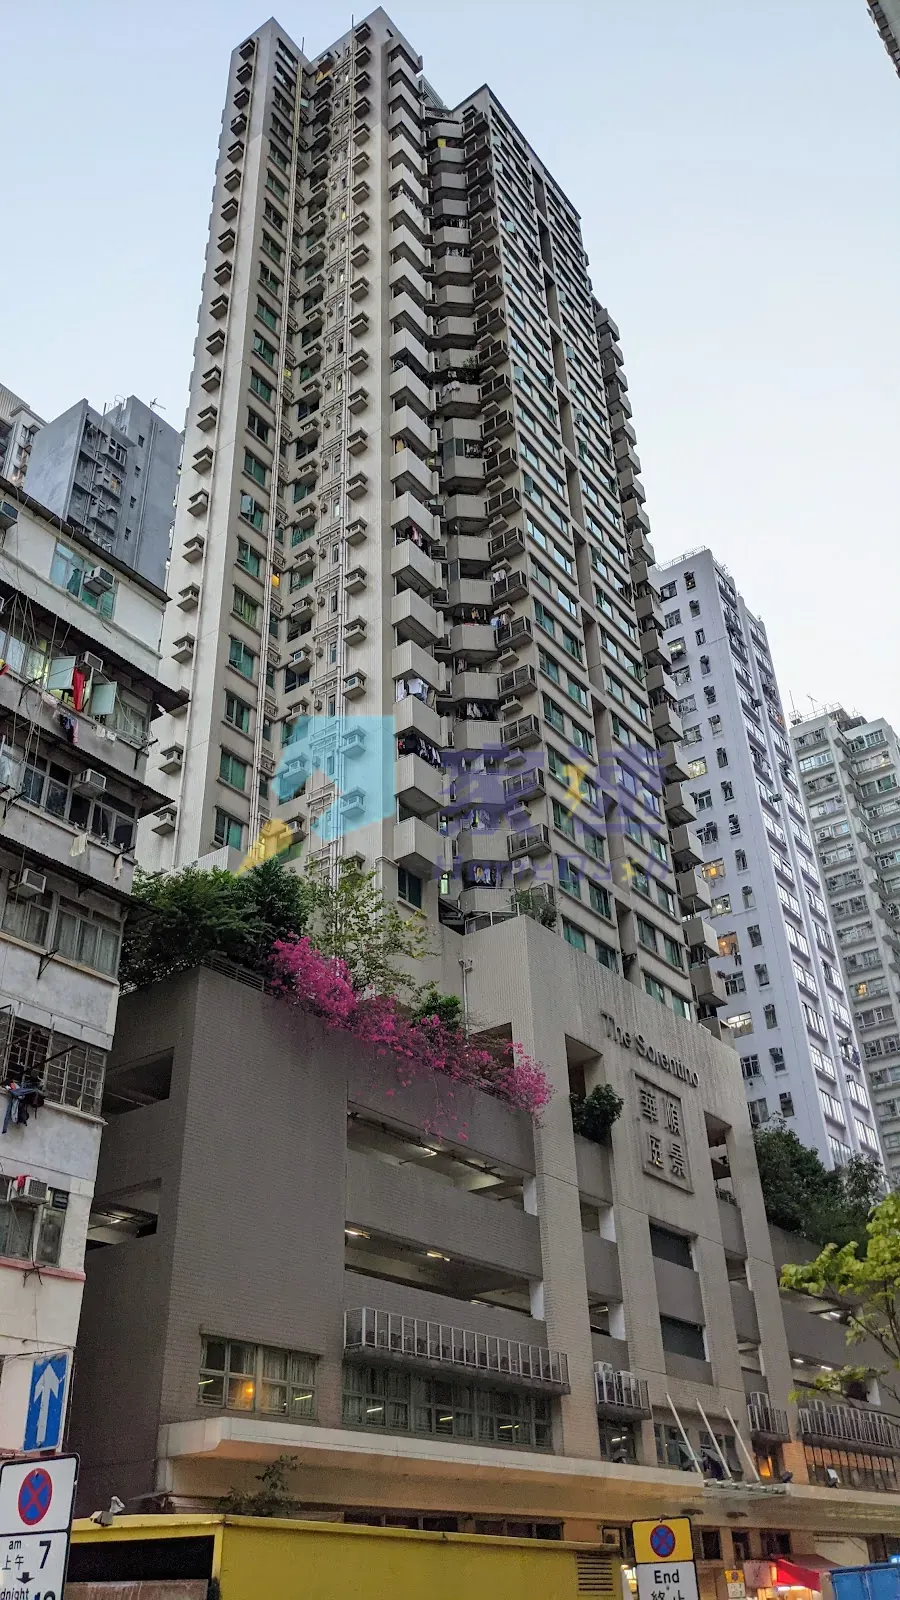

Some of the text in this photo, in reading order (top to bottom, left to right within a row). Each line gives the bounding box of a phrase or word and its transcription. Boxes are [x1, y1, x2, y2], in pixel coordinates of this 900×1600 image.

[601, 1011, 699, 1088] The Sorentino
[8, 1540, 21, 1550] am
[2, 1554, 24, 1570] 上午
[39, 1540, 51, 1569] 7
[654, 1569, 680, 1584] End
